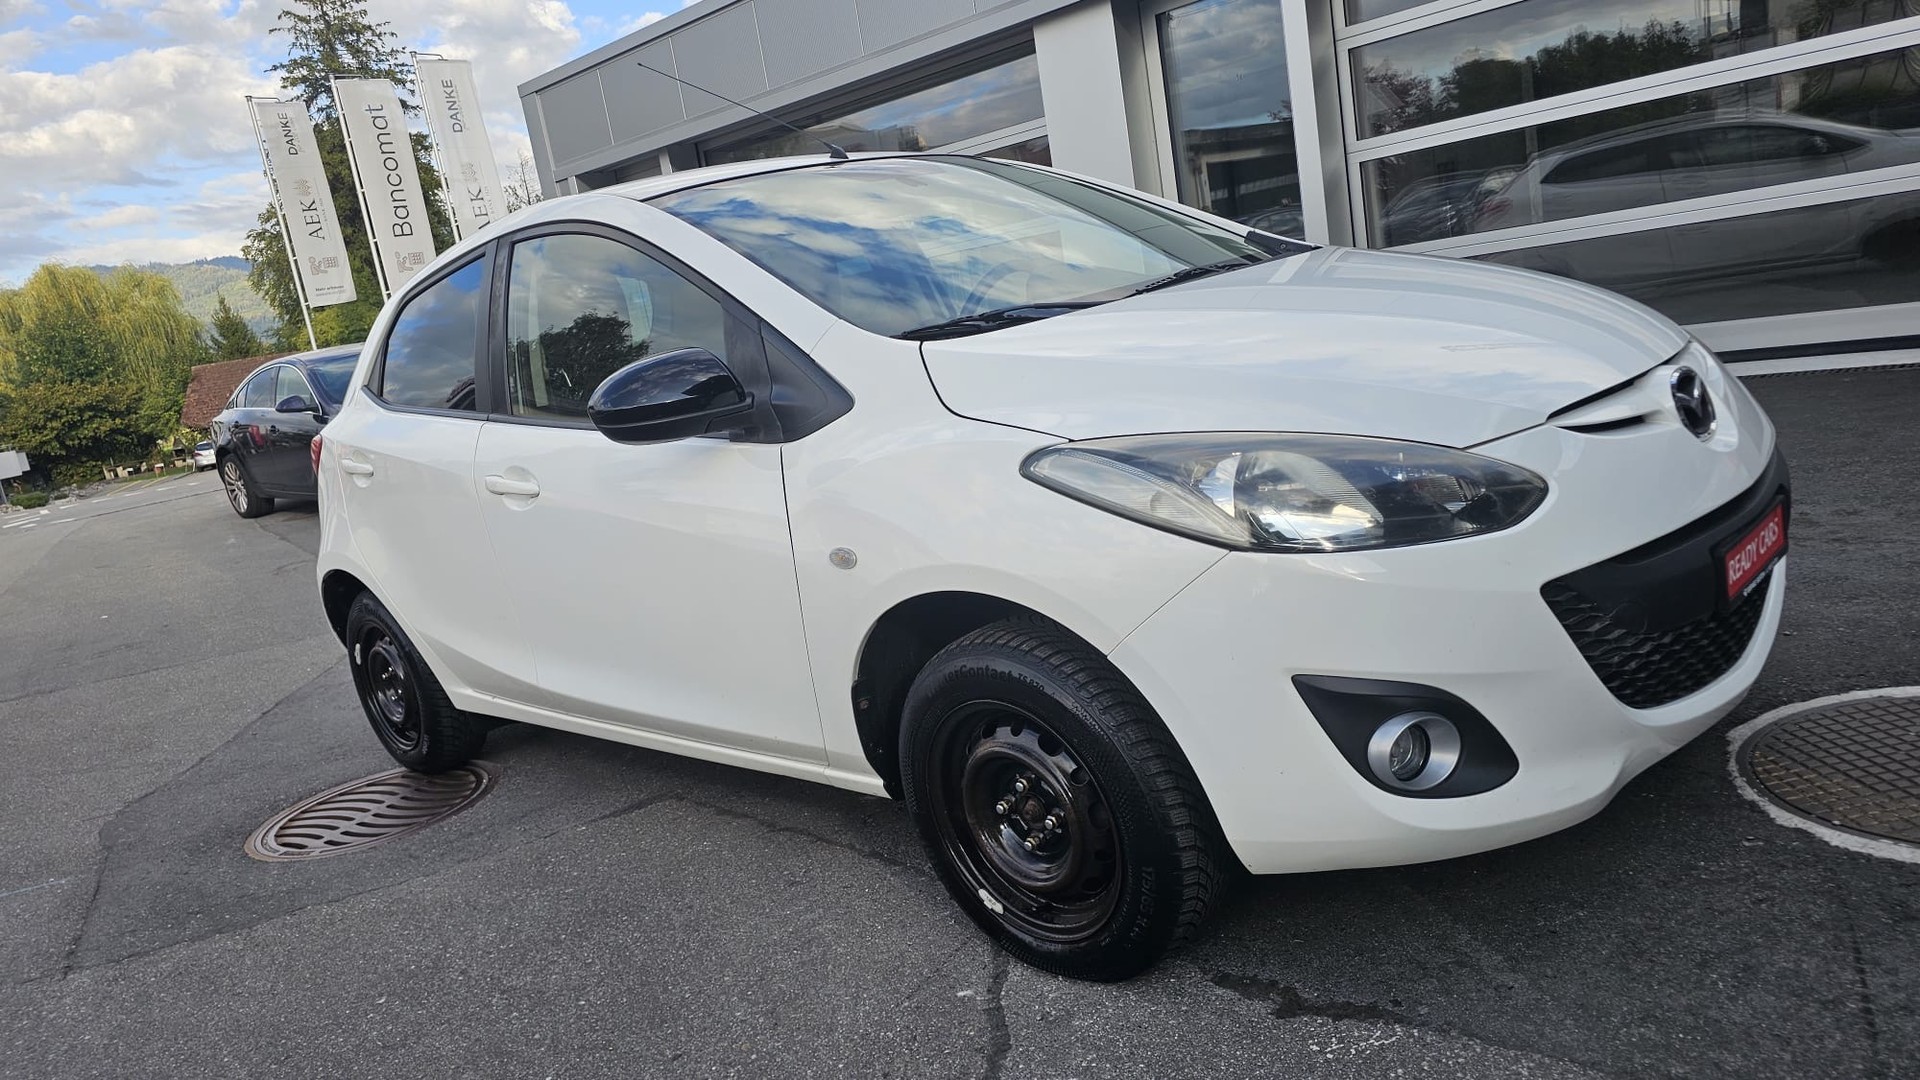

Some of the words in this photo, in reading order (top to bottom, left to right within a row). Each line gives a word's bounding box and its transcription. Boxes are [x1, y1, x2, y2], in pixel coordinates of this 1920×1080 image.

[441, 79, 463, 133] DANKE
[277, 112, 299, 156] DANKE
[365, 103, 413, 238] Bancomat
[300, 199, 325, 240] AEK
[1728, 537, 1758, 585] READY
[1759, 517, 1779, 554] CARS
